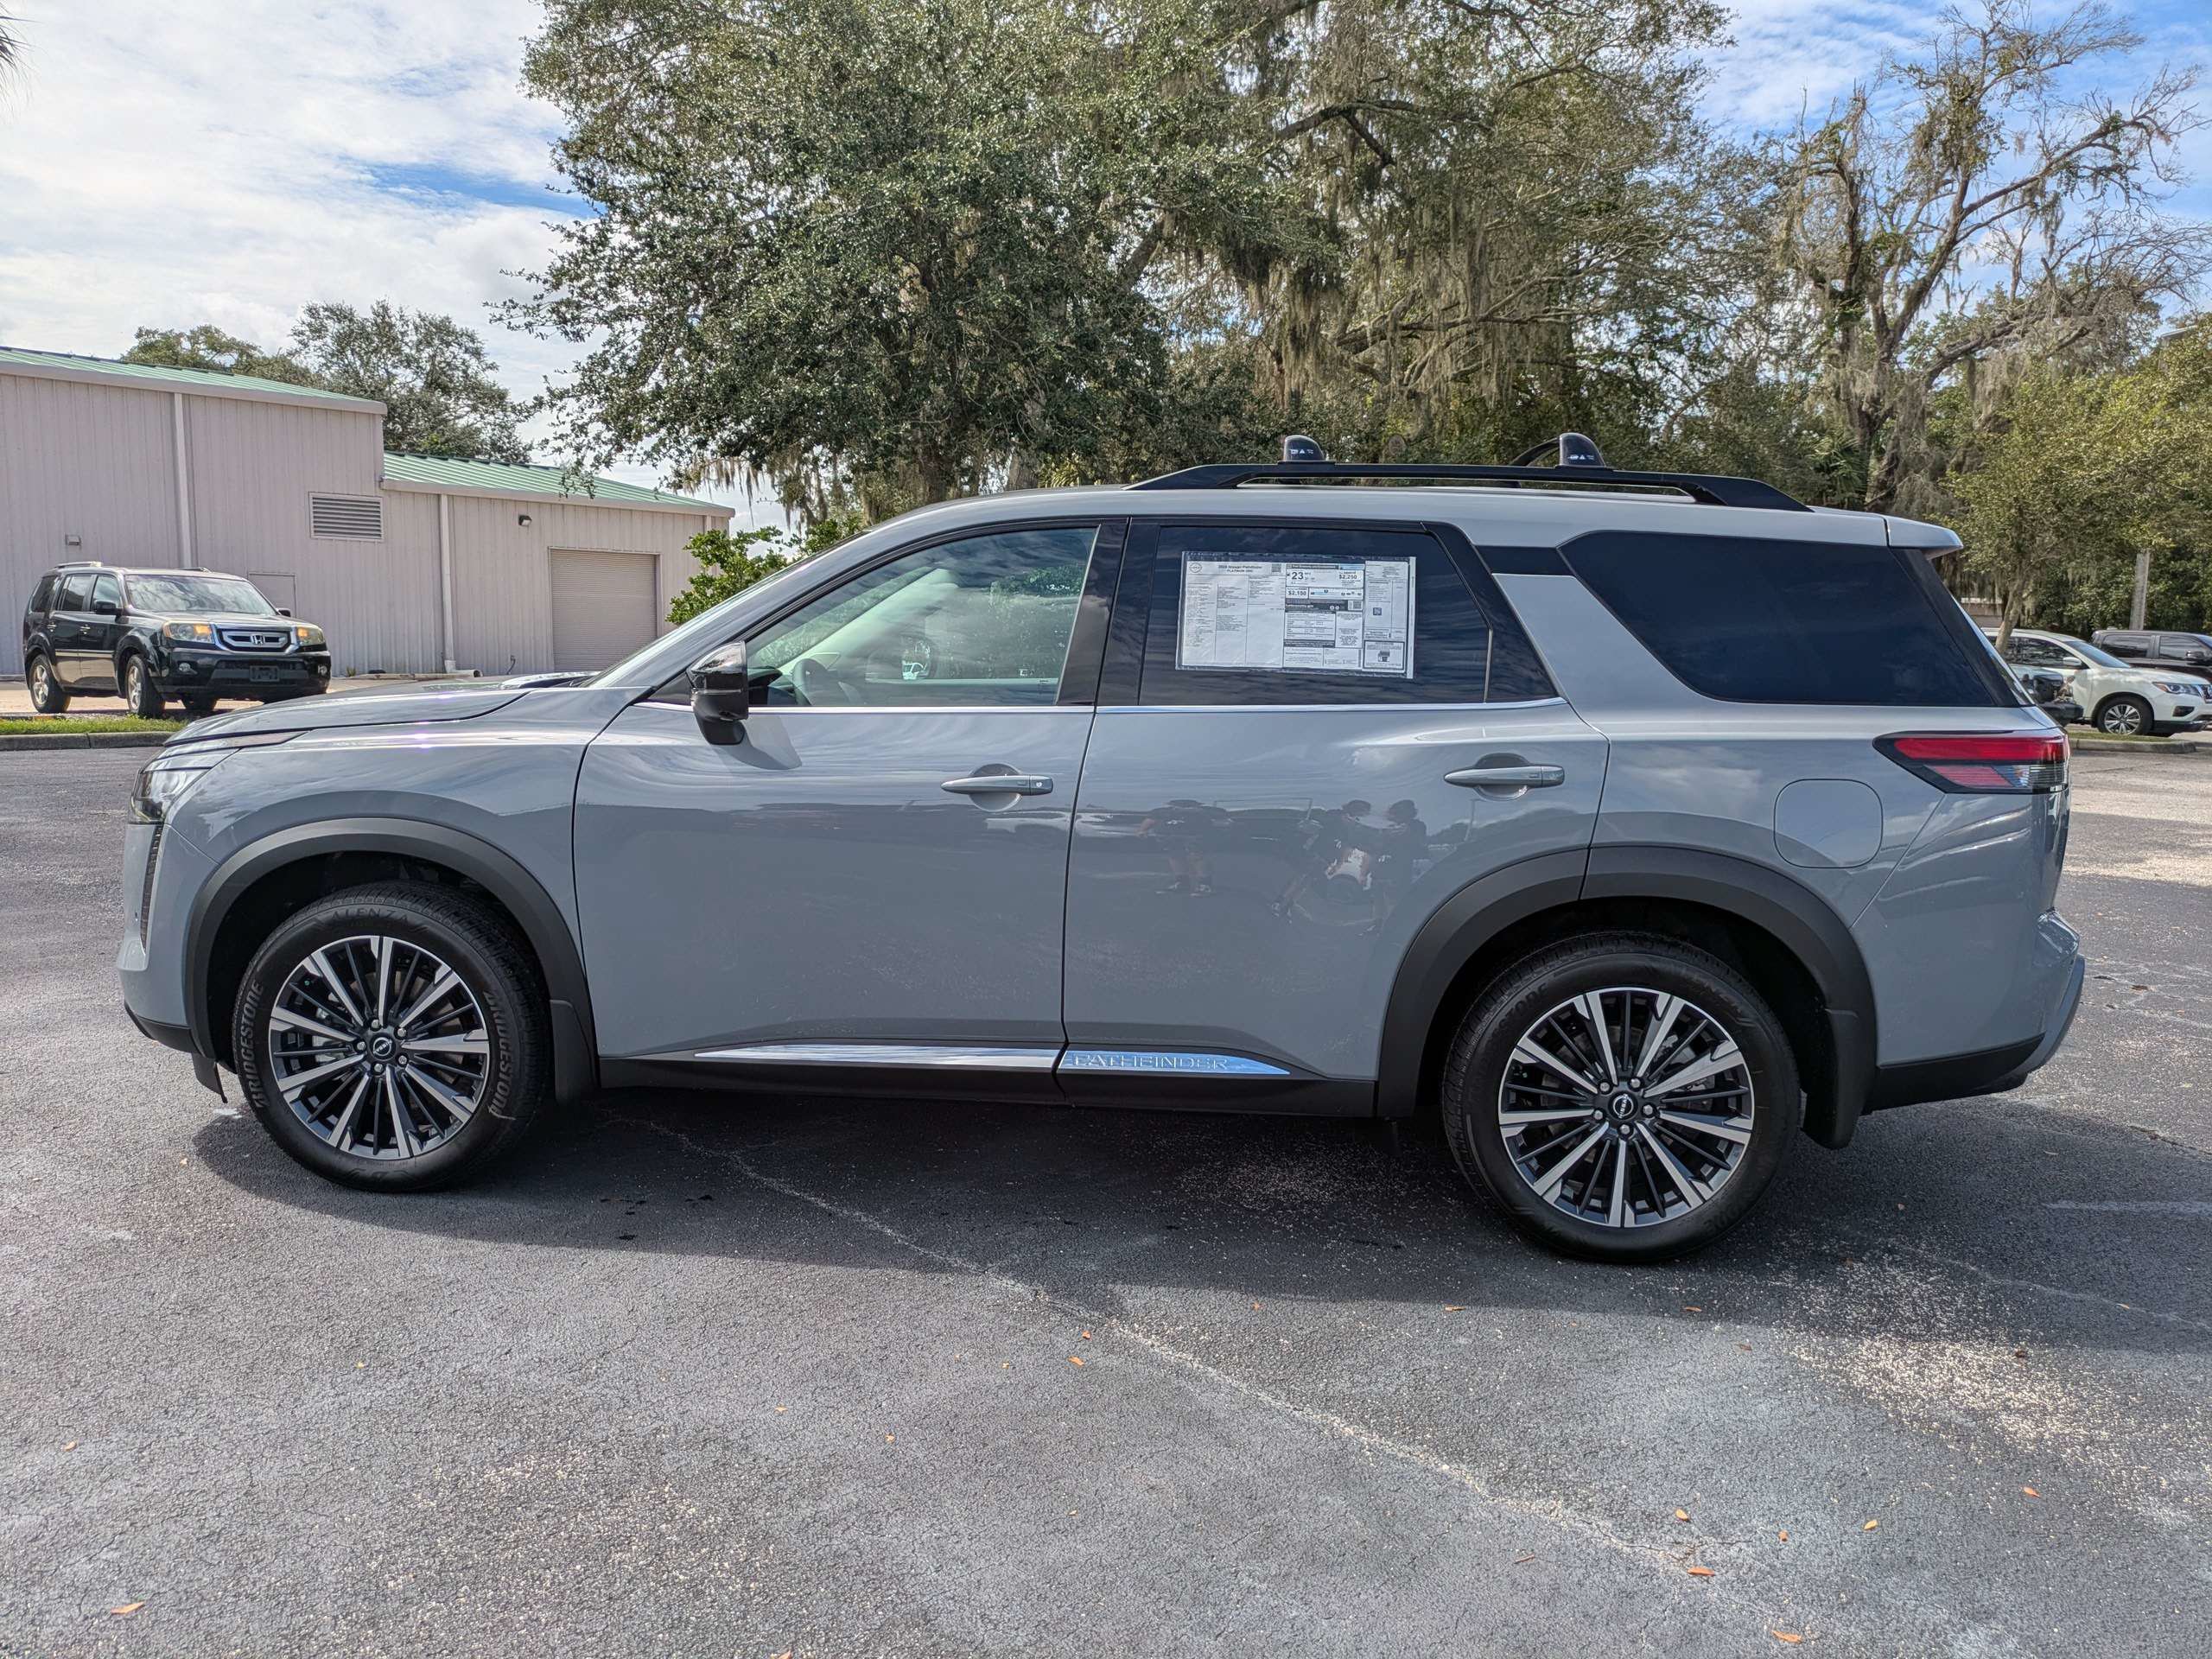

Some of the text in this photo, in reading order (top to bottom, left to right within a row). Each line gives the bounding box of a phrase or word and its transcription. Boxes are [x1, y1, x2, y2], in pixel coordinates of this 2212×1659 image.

[1292, 571, 1304, 580] 23
[331, 907, 410, 925] ALENZA
[240, 979, 270, 1108] BRIDGESTONE
[1074, 1054, 1229, 1071] PATHFINDER
